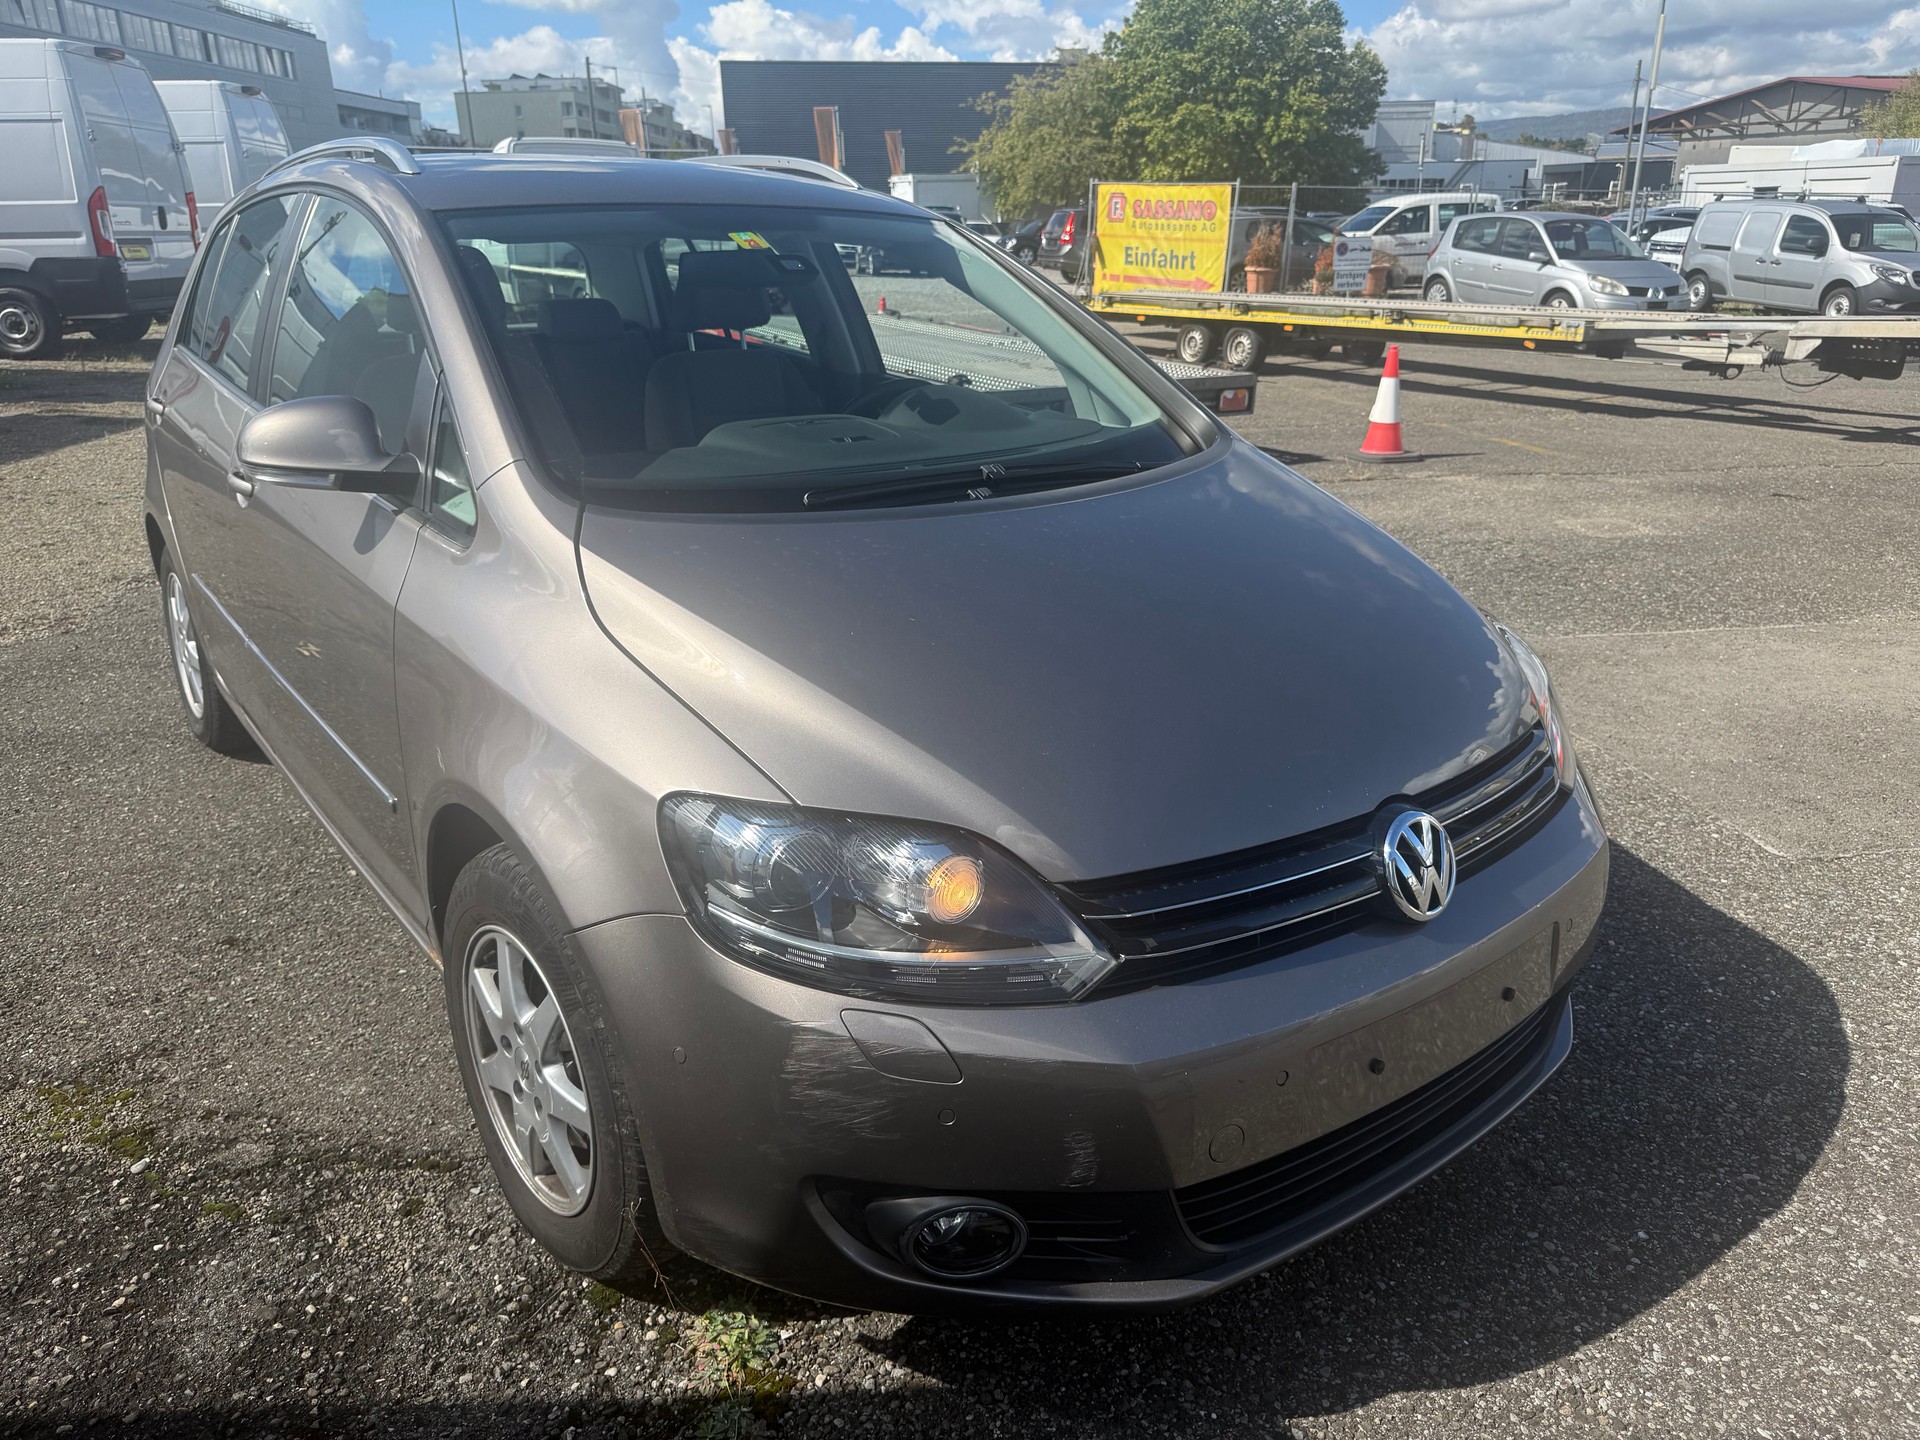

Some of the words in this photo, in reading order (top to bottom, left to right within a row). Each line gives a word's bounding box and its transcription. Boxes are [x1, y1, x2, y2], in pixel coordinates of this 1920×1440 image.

[1132, 199, 1217, 221] SASSANO
[1131, 221, 1197, 232] Autosassano
[1201, 222, 1216, 233] AG
[1124, 246, 1196, 270] Einfahrt
[1387, 812, 1454, 919] VW
